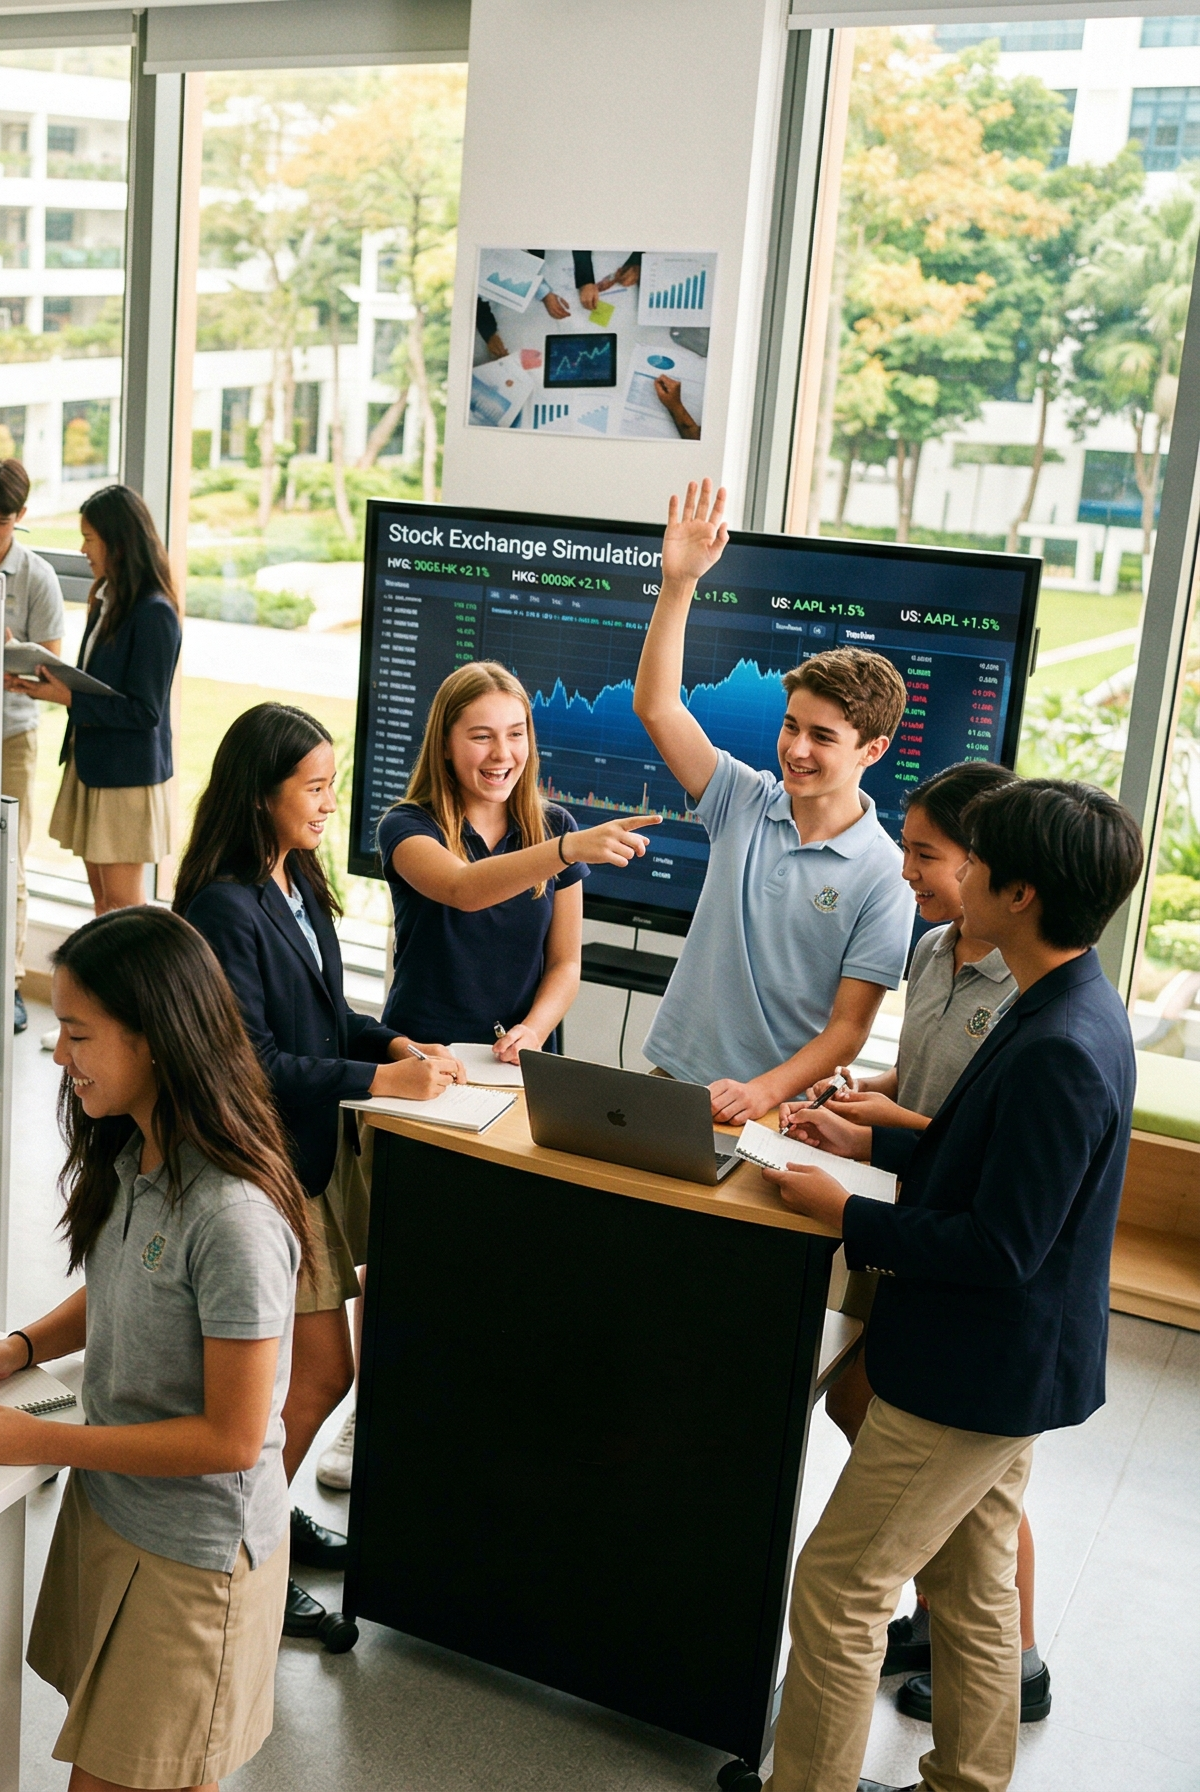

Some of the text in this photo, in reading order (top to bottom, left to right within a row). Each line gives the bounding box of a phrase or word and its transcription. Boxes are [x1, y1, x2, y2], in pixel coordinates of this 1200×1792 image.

[388, 523, 663, 568] Stock Exchange Simulation
[511, 569, 539, 584] HKG:
[771, 596, 866, 617] US: AAPL +1.5%
[900, 609, 1000, 632] US: AAPL +1.5%
